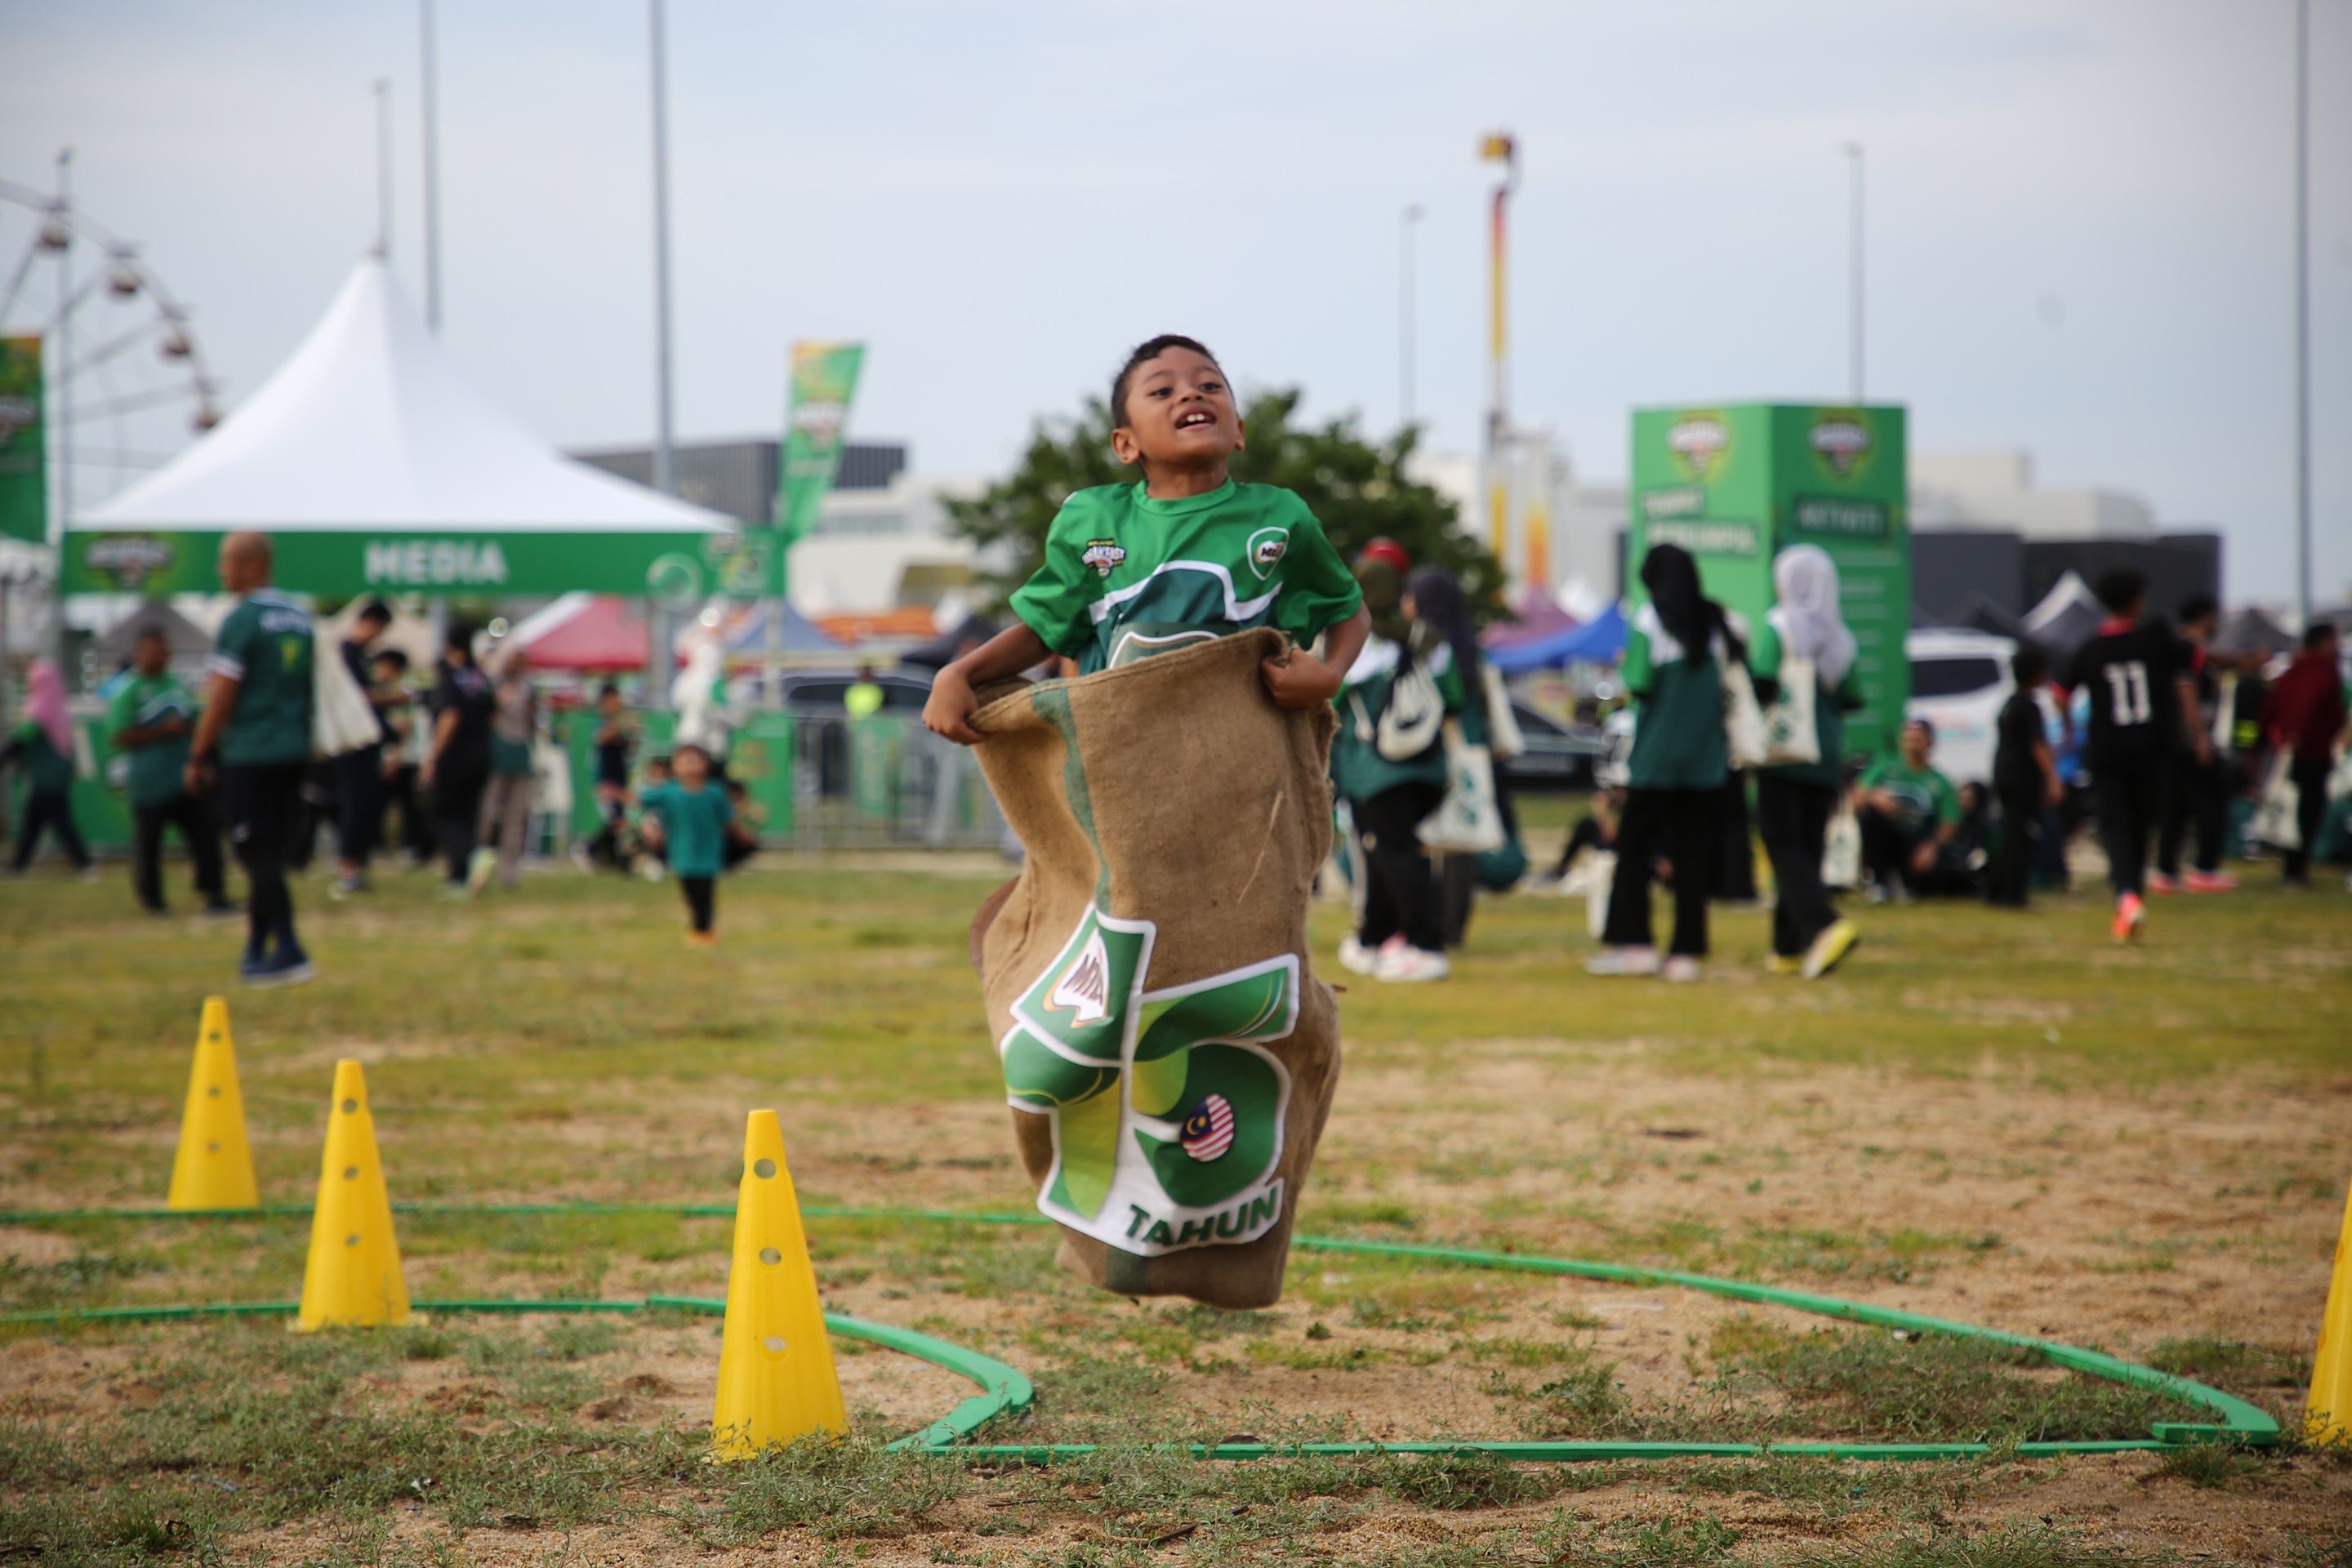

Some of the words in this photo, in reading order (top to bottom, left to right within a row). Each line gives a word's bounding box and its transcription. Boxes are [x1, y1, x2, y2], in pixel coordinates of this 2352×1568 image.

[365, 539, 509, 585] MEDIA
[2104, 661, 2152, 725] 11
[1126, 1186, 1277, 1246] TAHUN
